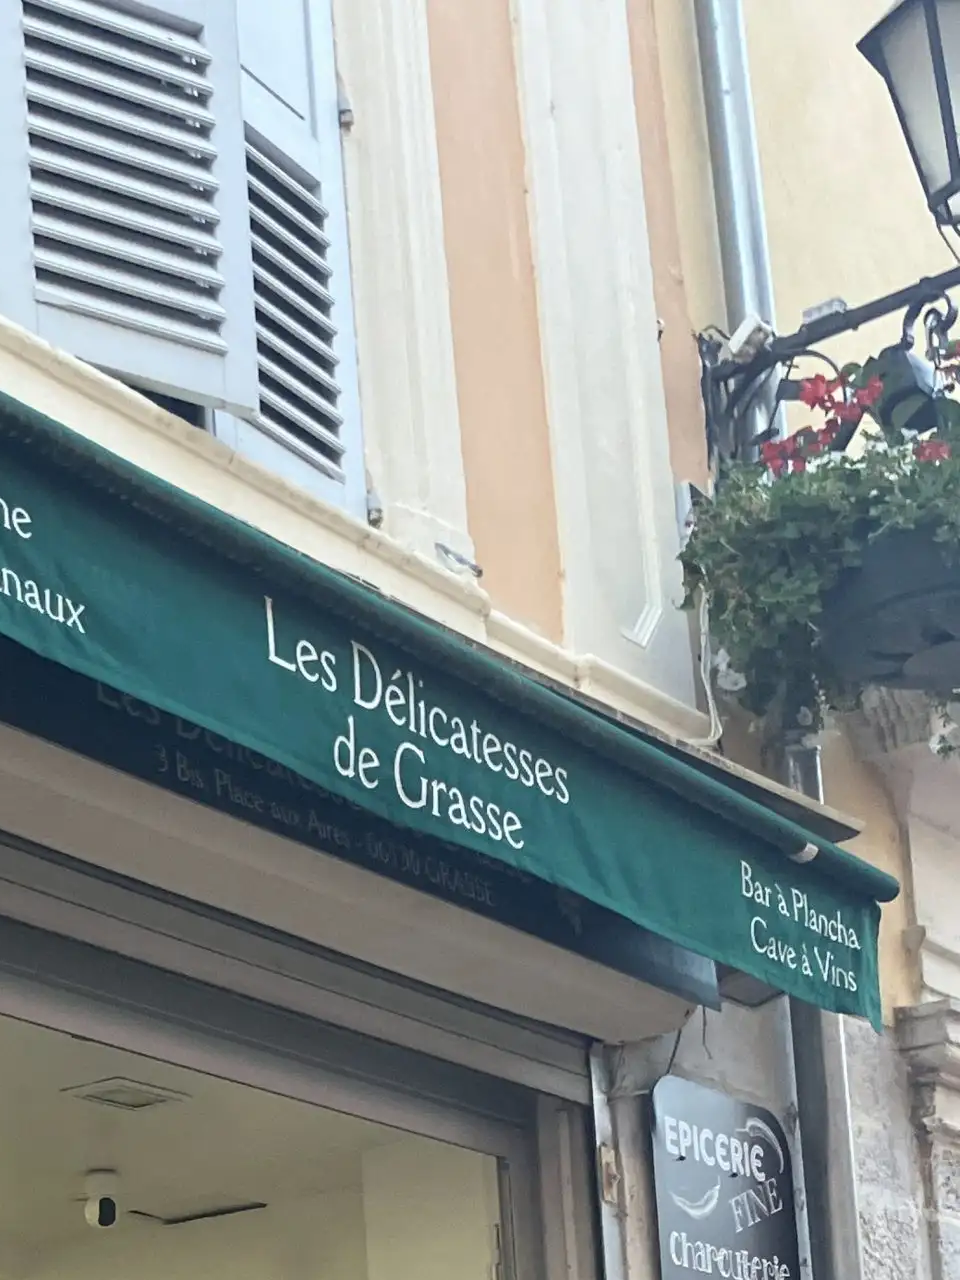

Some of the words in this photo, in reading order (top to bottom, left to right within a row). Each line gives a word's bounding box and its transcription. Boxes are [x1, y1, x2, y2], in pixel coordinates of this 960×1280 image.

[264, 595, 337, 692] Les
[349, 640, 570, 804] Délicatesses
[333, 715, 380, 789] de
[394, 742, 525, 849] Grasse
[740, 860, 772, 907] Bar
[775, 883, 790, 917] à
[791, 887, 861, 950] Plancha
[750, 916, 797, 969] Cave
[801, 944, 813, 977] à
[814, 947, 857, 992] Vins
[664, 1116, 766, 1181] EPICERIE
[729, 1178, 783, 1233] FINE
